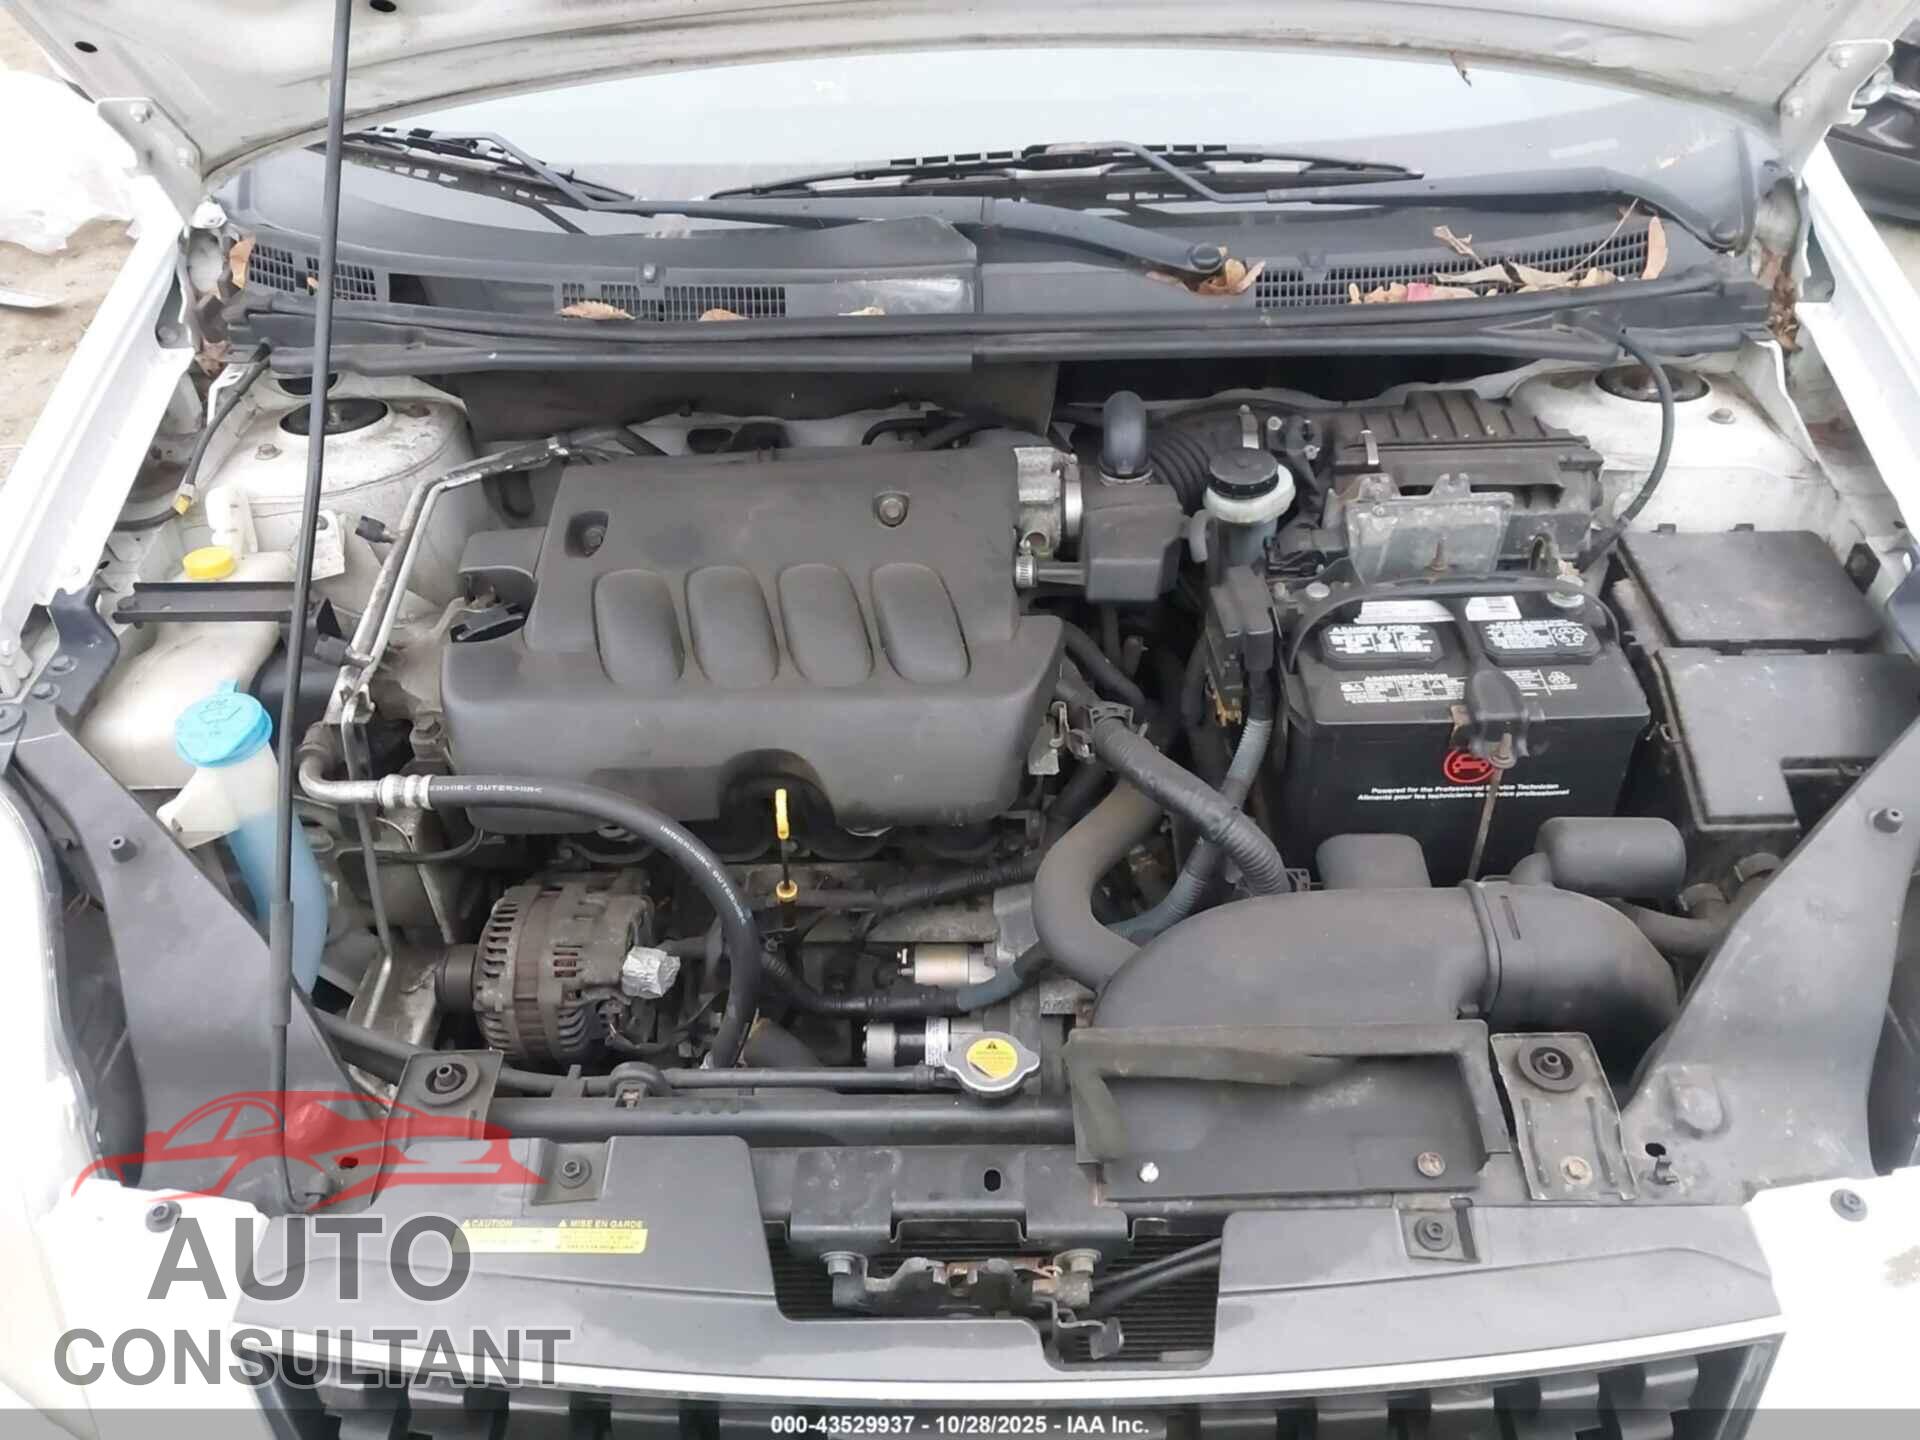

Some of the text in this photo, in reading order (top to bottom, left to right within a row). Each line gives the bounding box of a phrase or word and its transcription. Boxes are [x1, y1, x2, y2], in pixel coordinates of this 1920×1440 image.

[1435, 785, 1484, 793] Professional
[1517, 783, 1559, 791] Technician
[1393, 793, 1413, 801] pour
[1427, 792, 1472, 800] techniciens
[472, 1218, 512, 1228] CAUTION
[569, 1219, 643, 1229] MISE EN GARDE
